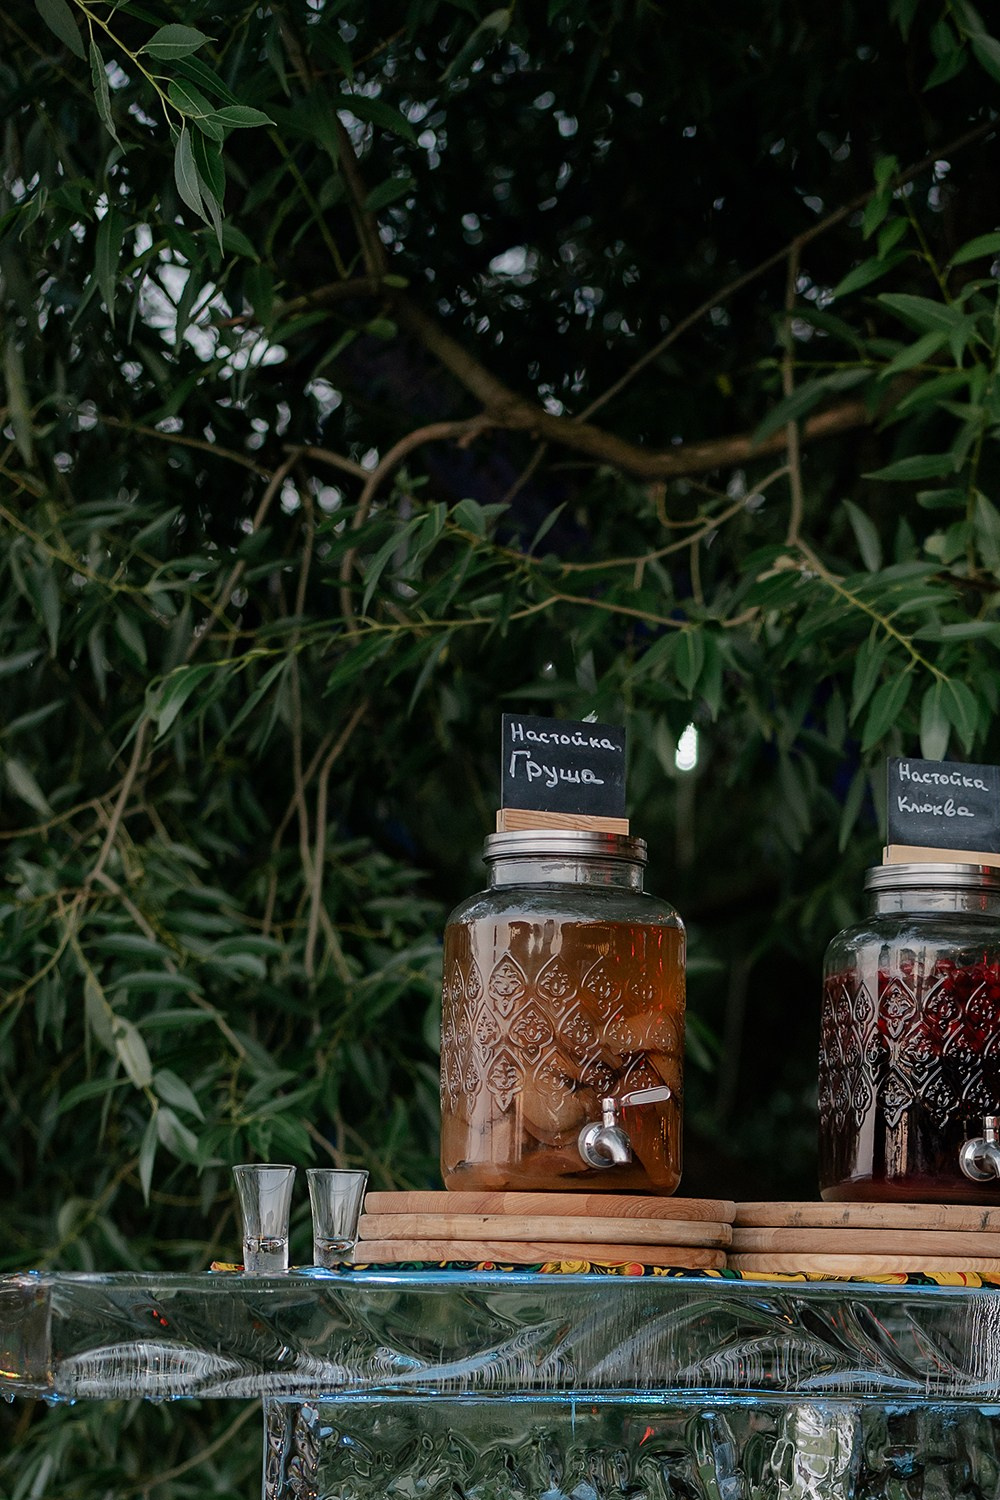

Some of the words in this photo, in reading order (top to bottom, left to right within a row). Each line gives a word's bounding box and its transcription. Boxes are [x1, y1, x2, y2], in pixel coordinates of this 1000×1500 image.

[510, 722, 616, 751] Настойка
[509, 750, 605, 788] Груша
[899, 762, 990, 792] Настойка
[897, 796, 975, 817] Клюква
